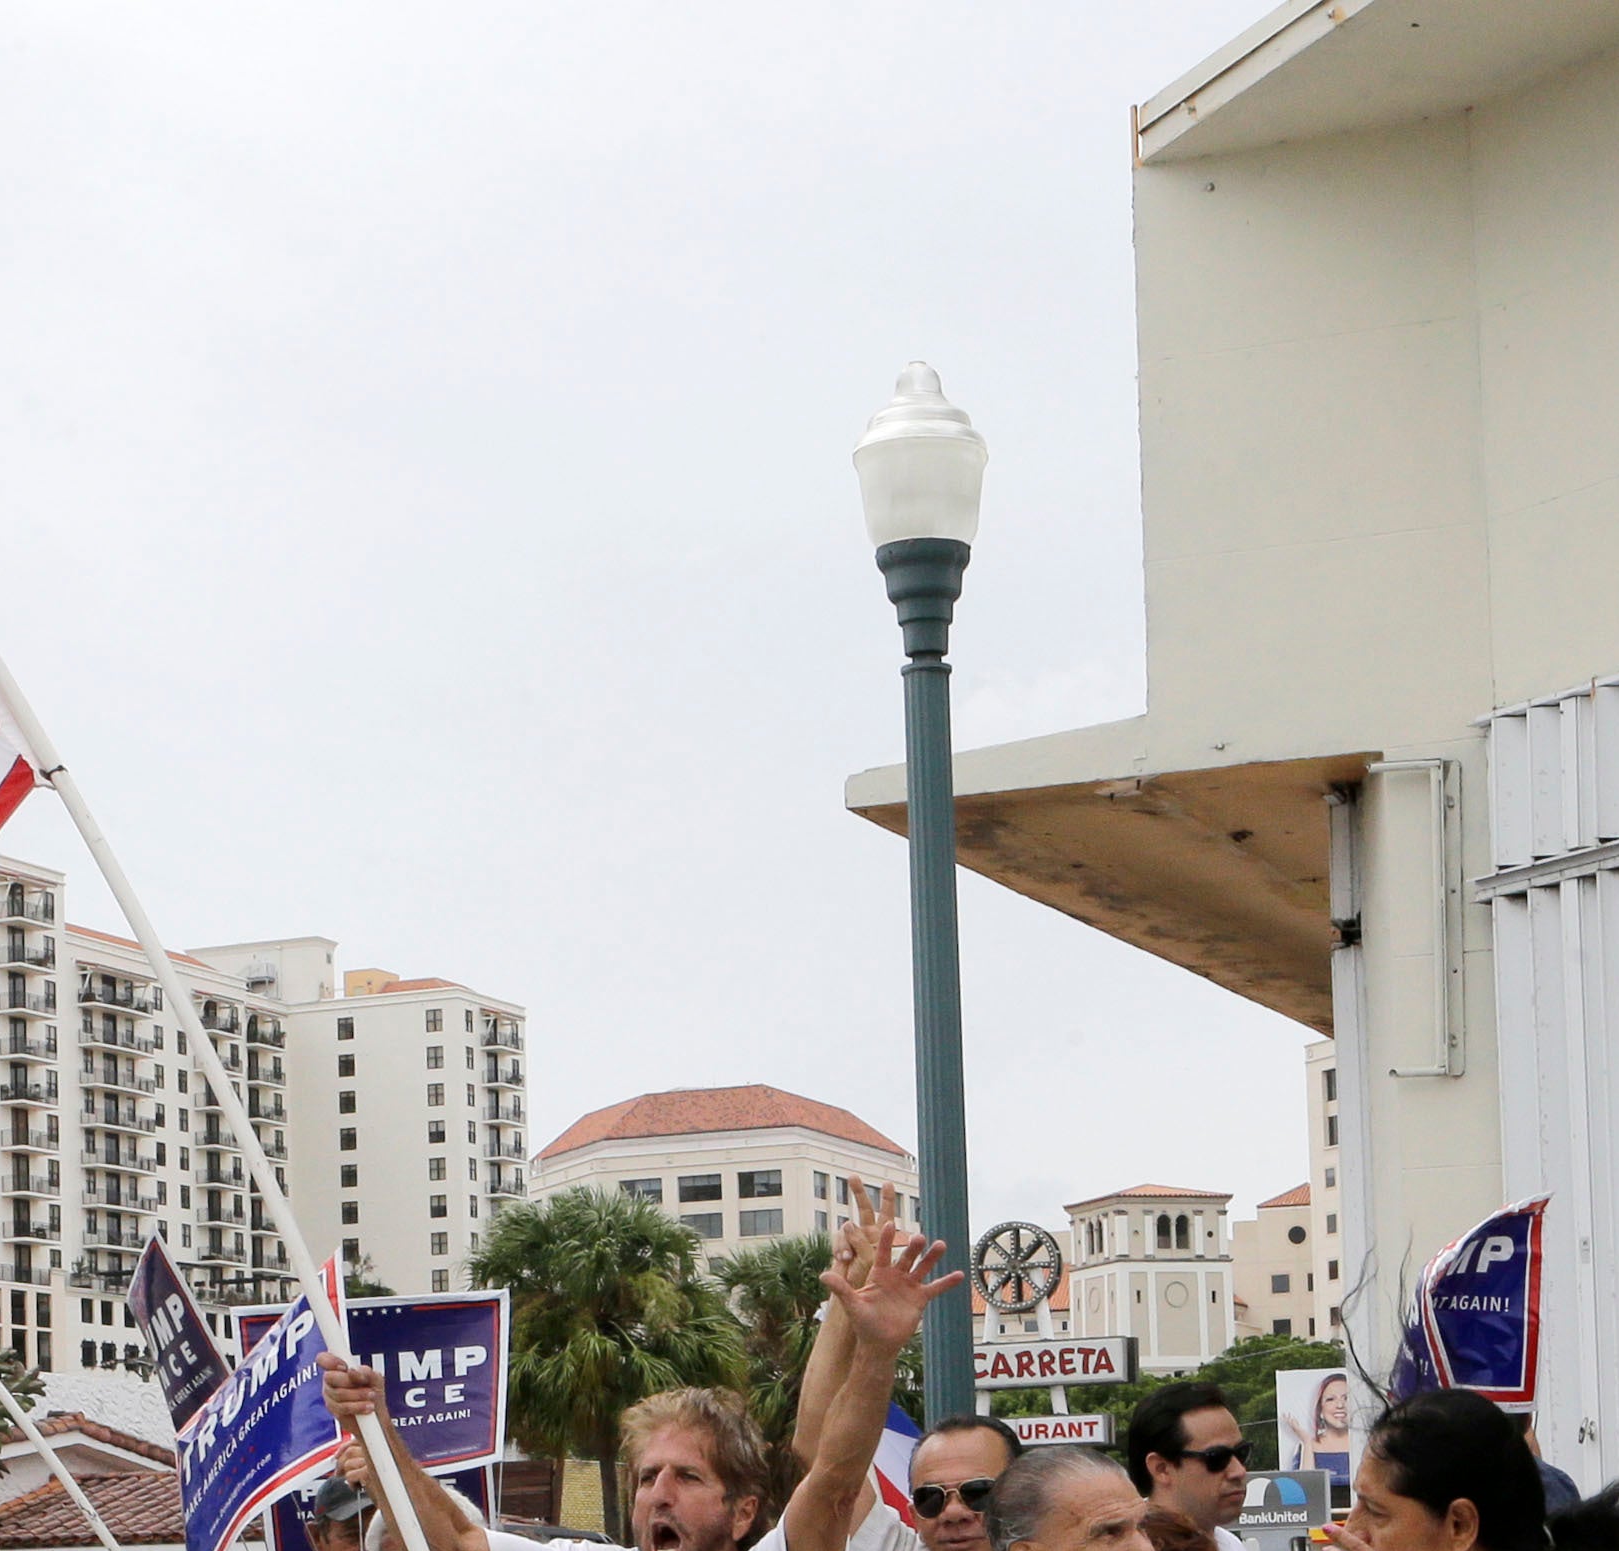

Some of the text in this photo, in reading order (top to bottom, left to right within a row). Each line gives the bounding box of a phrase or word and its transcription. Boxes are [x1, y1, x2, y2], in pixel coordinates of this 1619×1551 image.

[1449, 1295, 1511, 1313] AGAIN!
[973, 1346, 1115, 1380] CARRETA
[183, 1310, 314, 1485] TRUMP
[427, 1408, 471, 1425] AGAIN!
[203, 1433, 238, 1495] AMERICA
[238, 1402, 269, 1441] GREAT
[271, 1362, 318, 1408] AGAIN!
[1018, 1421, 1099, 1441] URANT
[1239, 1510, 1307, 1525] BankUnited
